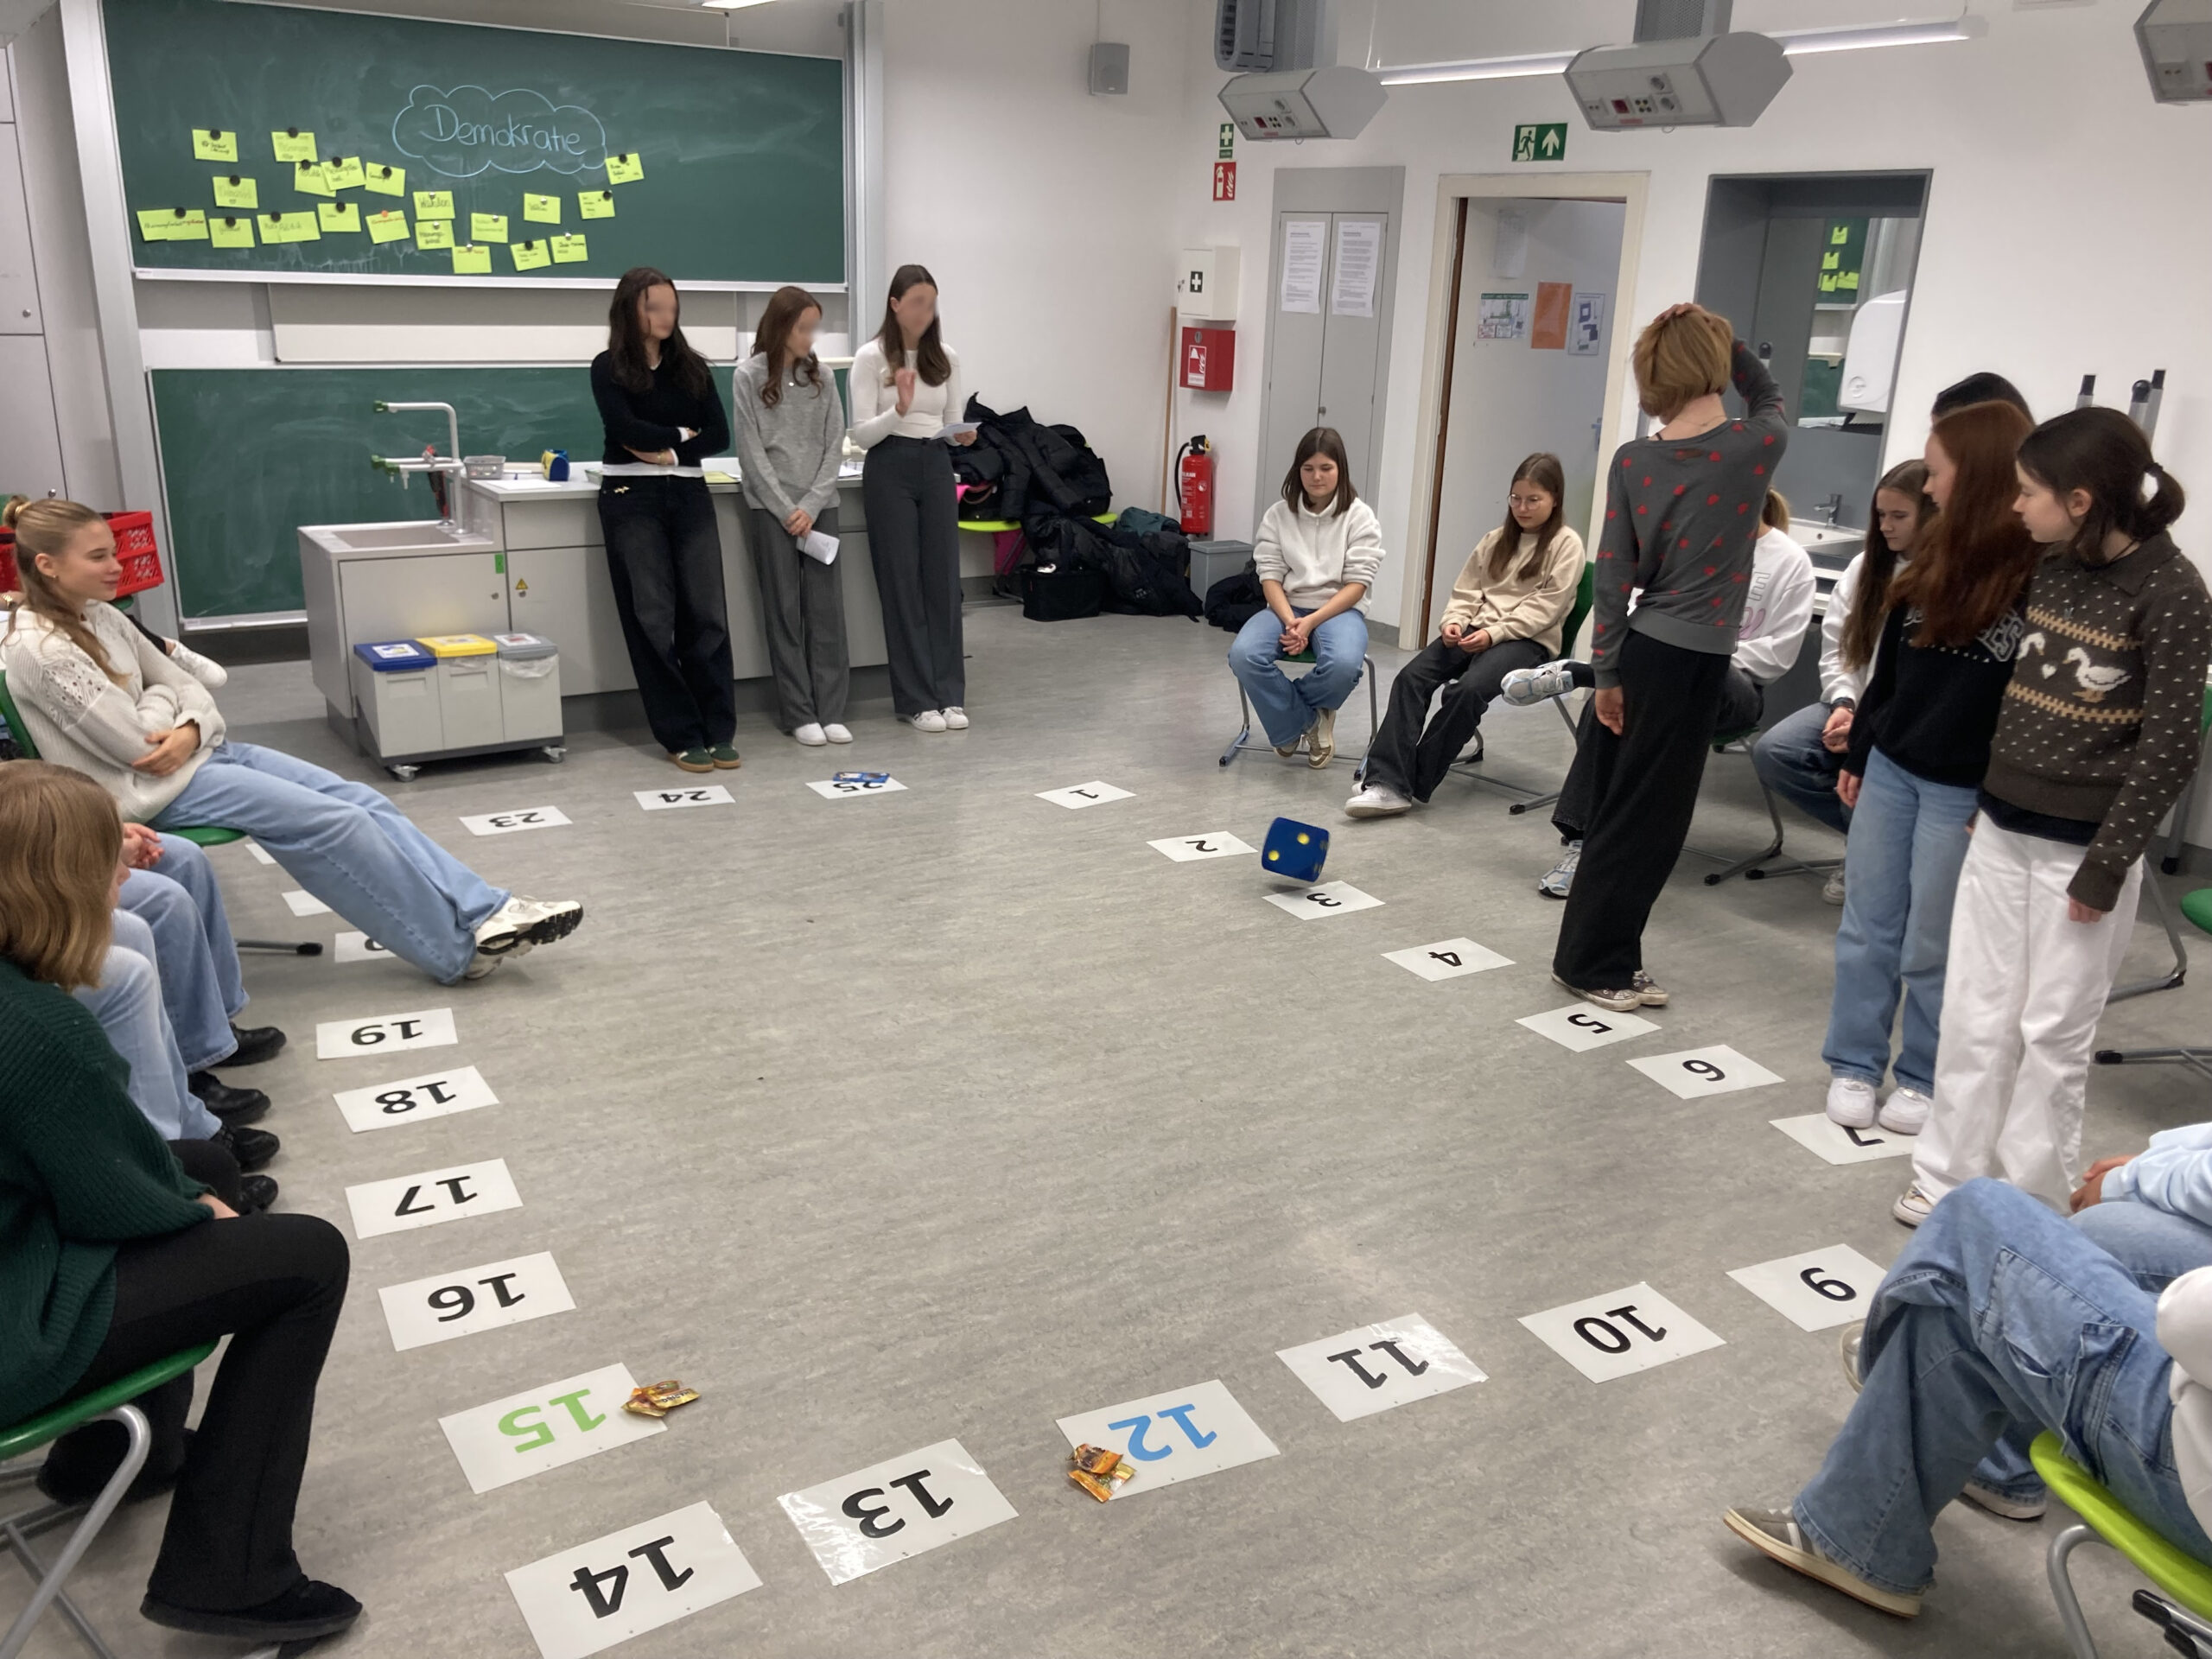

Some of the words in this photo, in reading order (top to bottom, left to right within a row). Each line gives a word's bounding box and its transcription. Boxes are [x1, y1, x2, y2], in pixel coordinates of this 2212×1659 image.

[420, 104, 587, 156] Demokratie
[658, 790, 711, 804] 24
[1069, 789, 1100, 800] 1
[488, 812, 546, 829] 23
[1185, 839, 1218, 853] 2
[1306, 892, 1342, 908] 3
[1428, 950, 1463, 968] 4
[351, 1019, 423, 1046] 19
[1567, 1013, 1613, 1035] 5
[1682, 1059, 1726, 1083] 6
[374, 1080, 457, 1116] 18
[394, 1175, 479, 1217] 17
[427, 1272, 526, 1323] 16
[1800, 1267, 1858, 1302] 9
[1573, 1304, 1668, 1355] 10
[1326, 1338, 1430, 1390] 11
[497, 1389, 607, 1454] 15
[1108, 1402, 1217, 1463] 12
[840, 1468, 955, 1540] 13
[569, 1535, 695, 1620] 14
